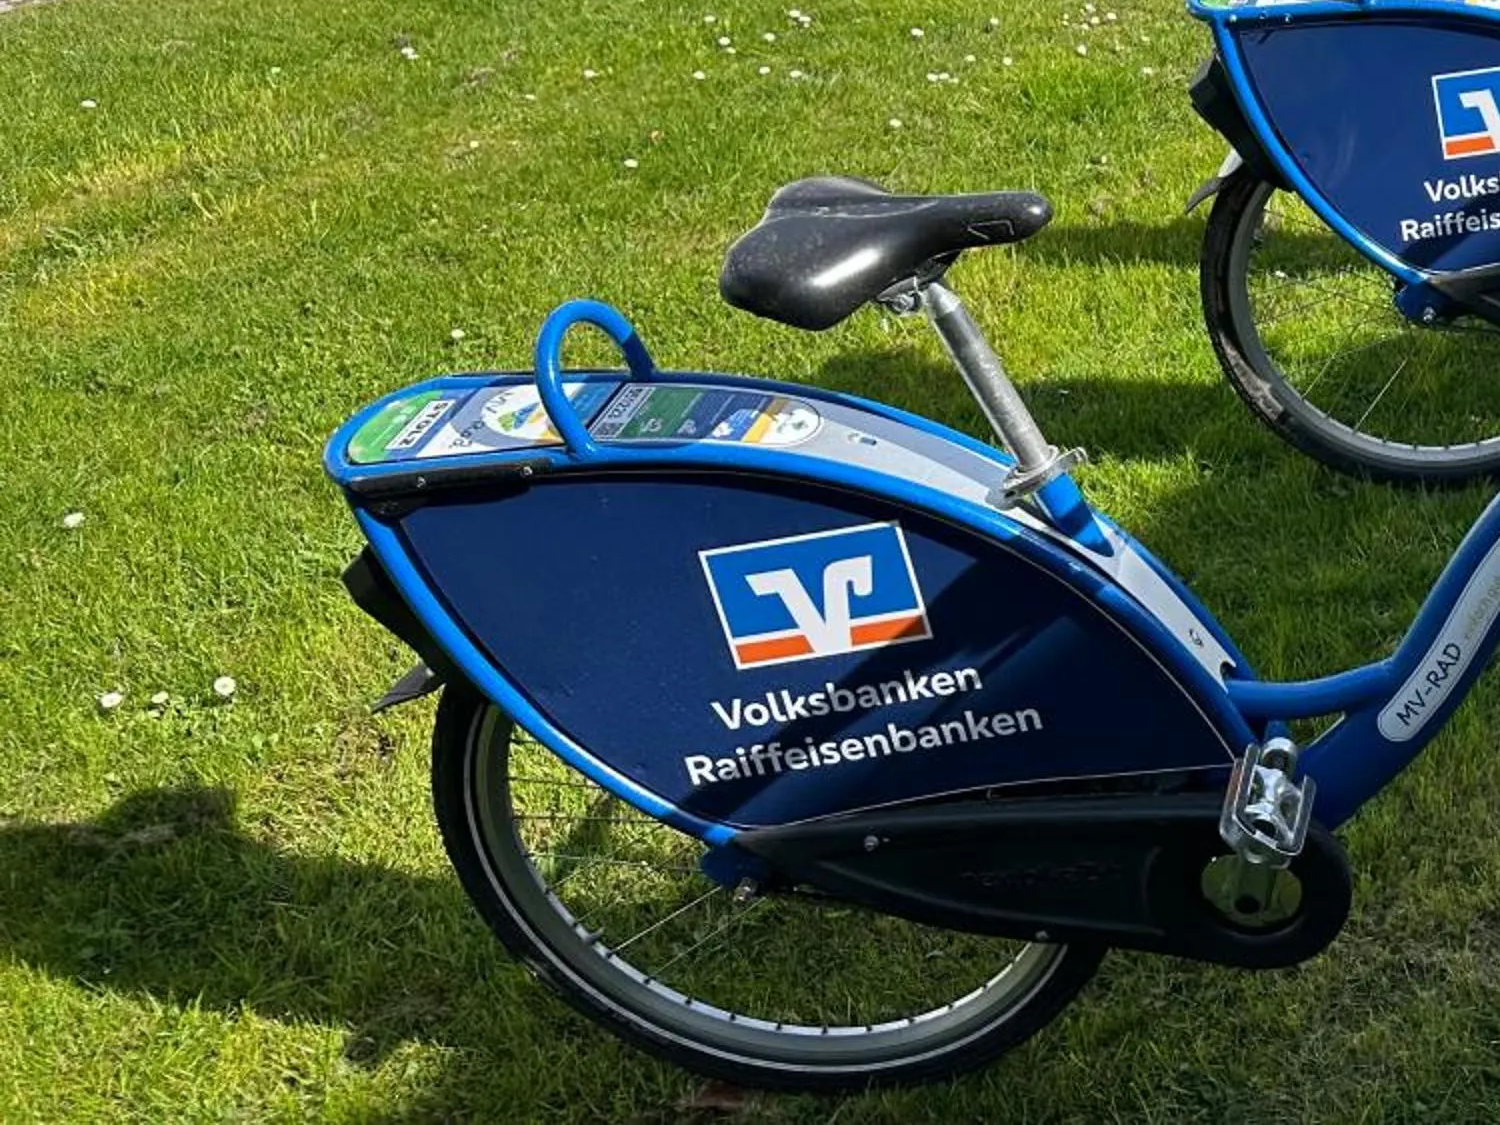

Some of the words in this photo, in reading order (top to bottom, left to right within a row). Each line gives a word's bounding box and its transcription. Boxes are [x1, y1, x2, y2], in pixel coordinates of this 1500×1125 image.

[711, 667, 983, 730] Volksbanken
[1396, 641, 1462, 726] MV-RAD
[684, 707, 1044, 786] Raiffeisenbanken
